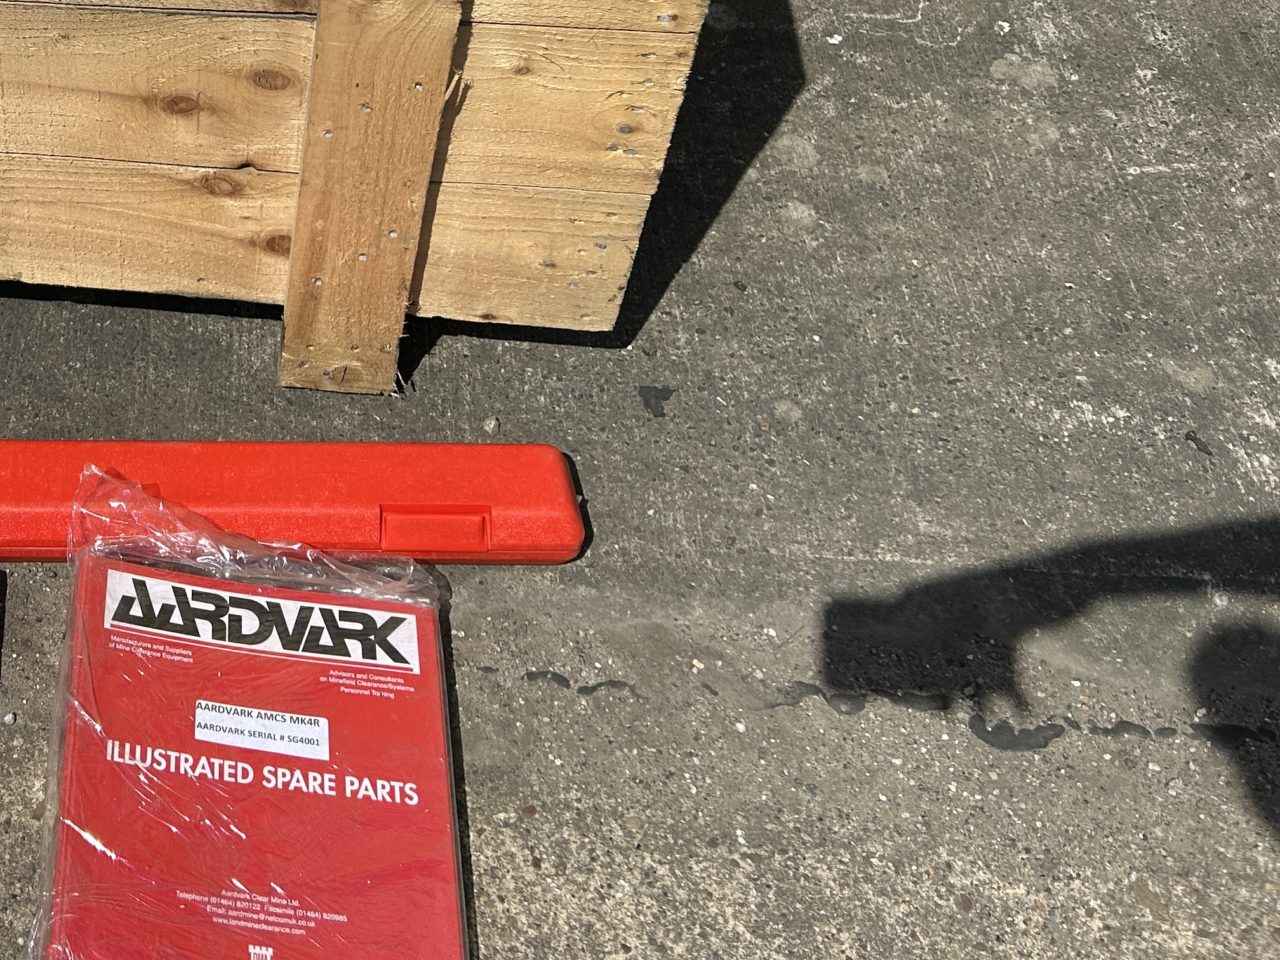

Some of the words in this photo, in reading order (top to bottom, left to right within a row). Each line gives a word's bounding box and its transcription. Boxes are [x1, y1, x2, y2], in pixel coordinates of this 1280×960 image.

[111, 578, 411, 665] AARDVARK
[116, 643, 131, 652] Mine
[162, 652, 194, 663] Equipment
[165, 645, 192, 656] Suppliers
[329, 669, 355, 678] Advisors
[329, 676, 356, 686] Minefield
[340, 686, 370, 695] Personnel
[196, 702, 253, 718] AARDVARK
[255, 712, 287, 723] AMCS
[289, 715, 320, 727] MK4R
[197, 722, 245, 736] AARDVARK
[247, 730, 278, 741] SERIAL
[287, 735, 320, 746] SG4001
[106, 739, 254, 784] ILLUSTRATED
[262, 766, 337, 795] SPARE
[344, 775, 420, 806] PARTS
[176, 890, 209, 903] Telephone
[221, 889, 250, 900] Aardvark
[251, 893, 269, 902] Clear
[270, 896, 287, 905] Mine
